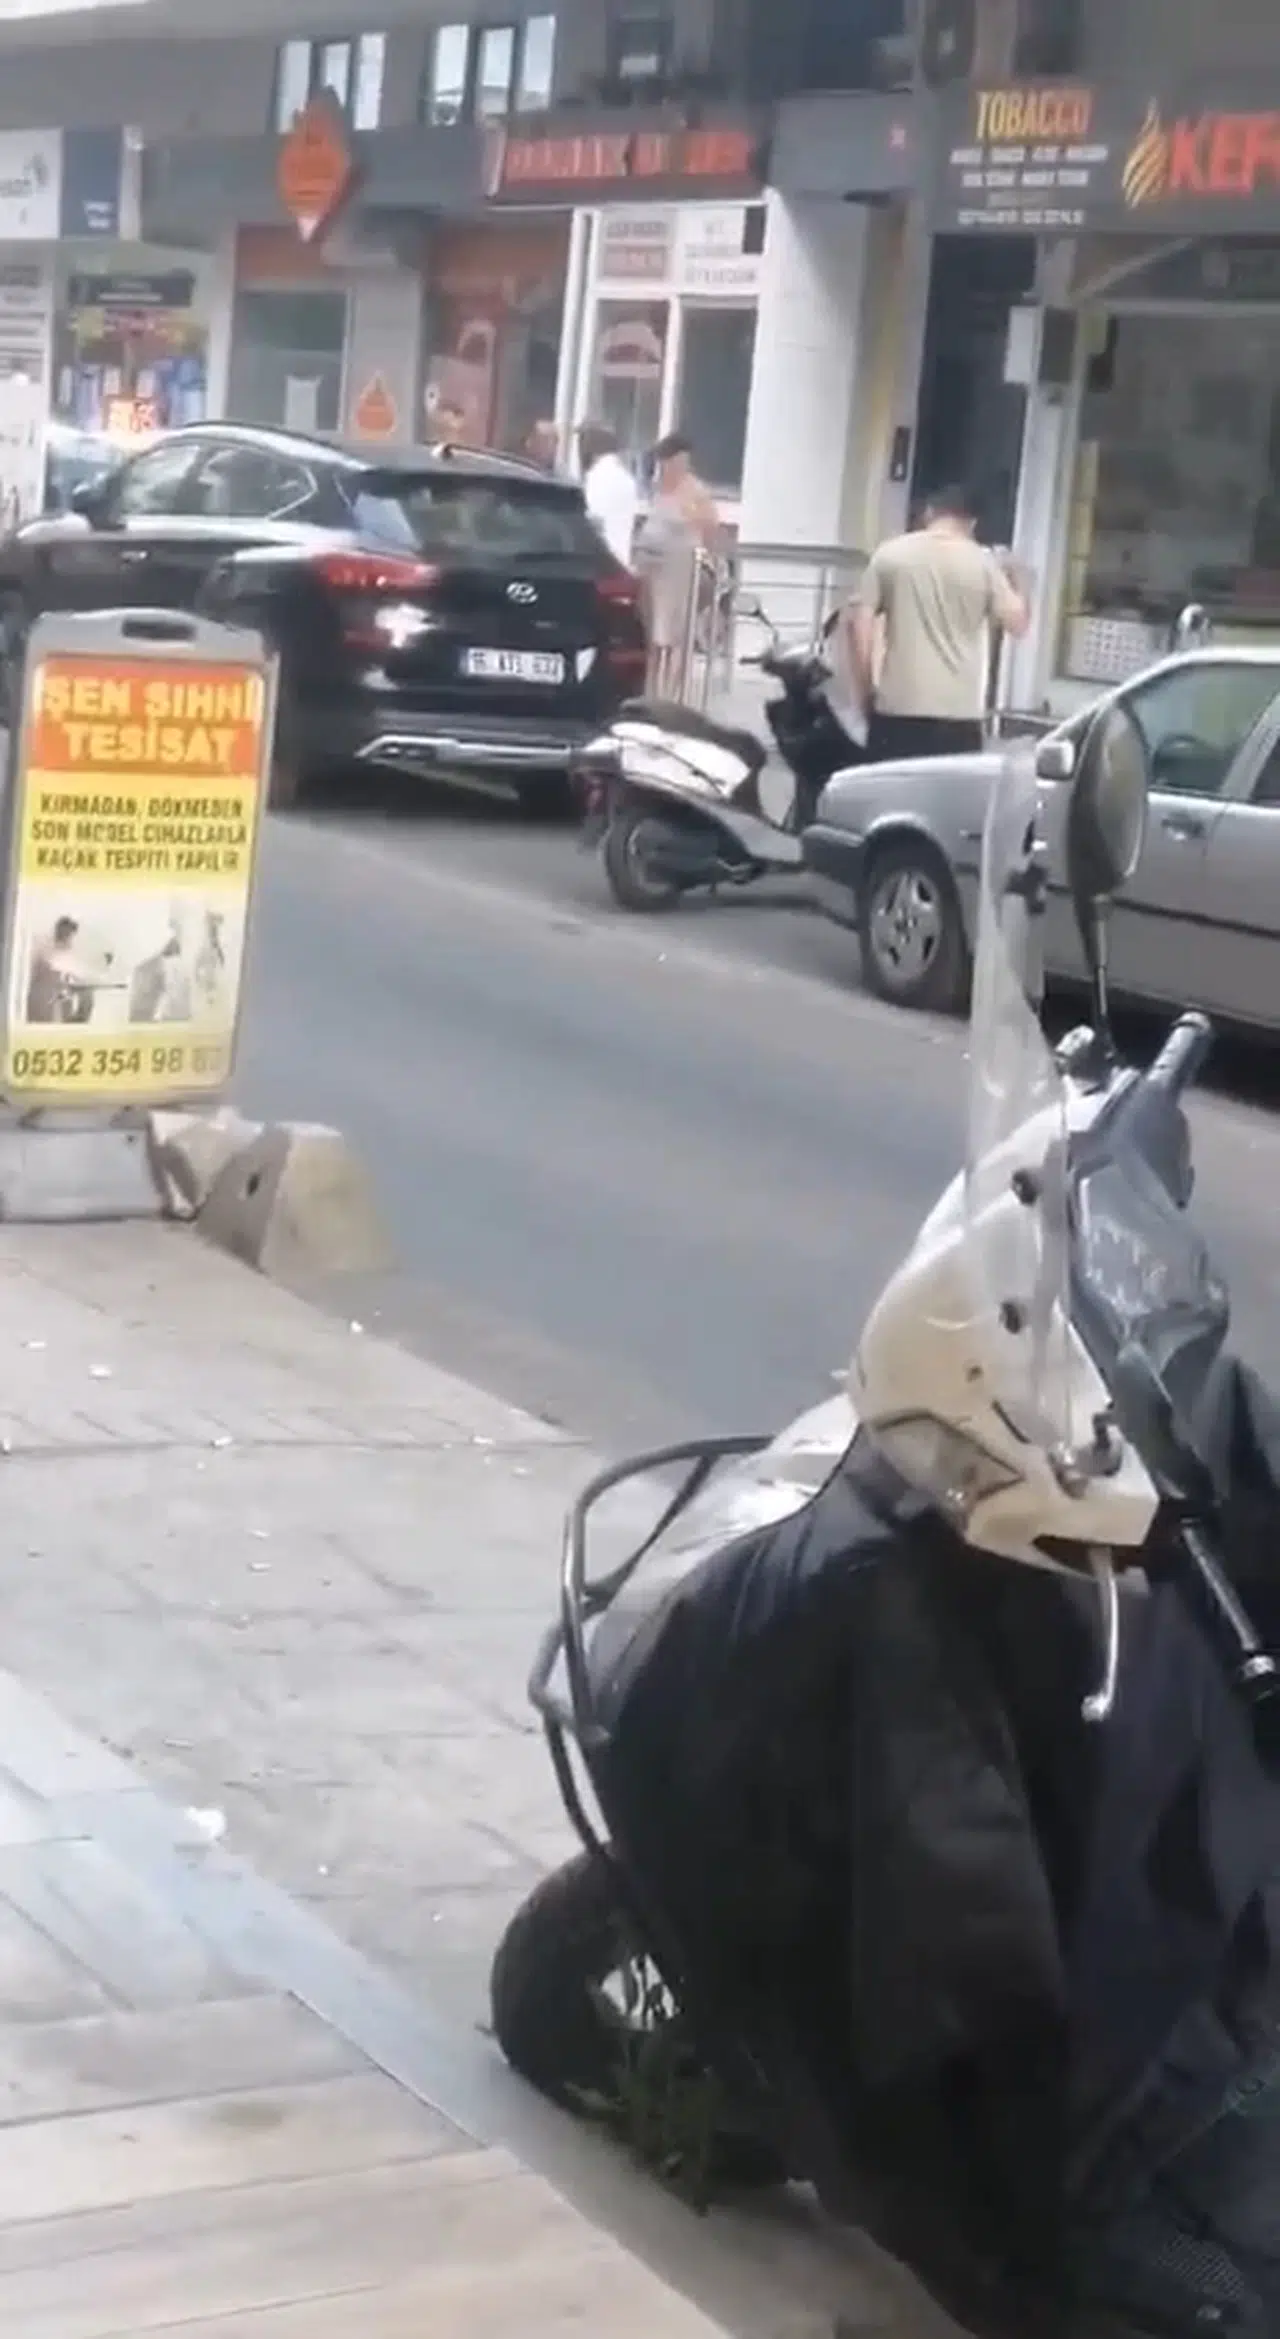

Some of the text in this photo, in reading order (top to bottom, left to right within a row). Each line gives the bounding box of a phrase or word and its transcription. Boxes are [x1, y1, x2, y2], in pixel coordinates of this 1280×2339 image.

[975, 89, 1092, 140] TOBACCO
[61, 719, 237, 766] TESİSAT
[31, 820, 70, 841] SON
[76, 822, 138, 843] MODEL
[37, 850, 97, 873] KAÇAK
[12, 1049, 83, 1077] 0532
[91, 1050, 141, 1075] 354
[151, 1048, 184, 1074] 98
